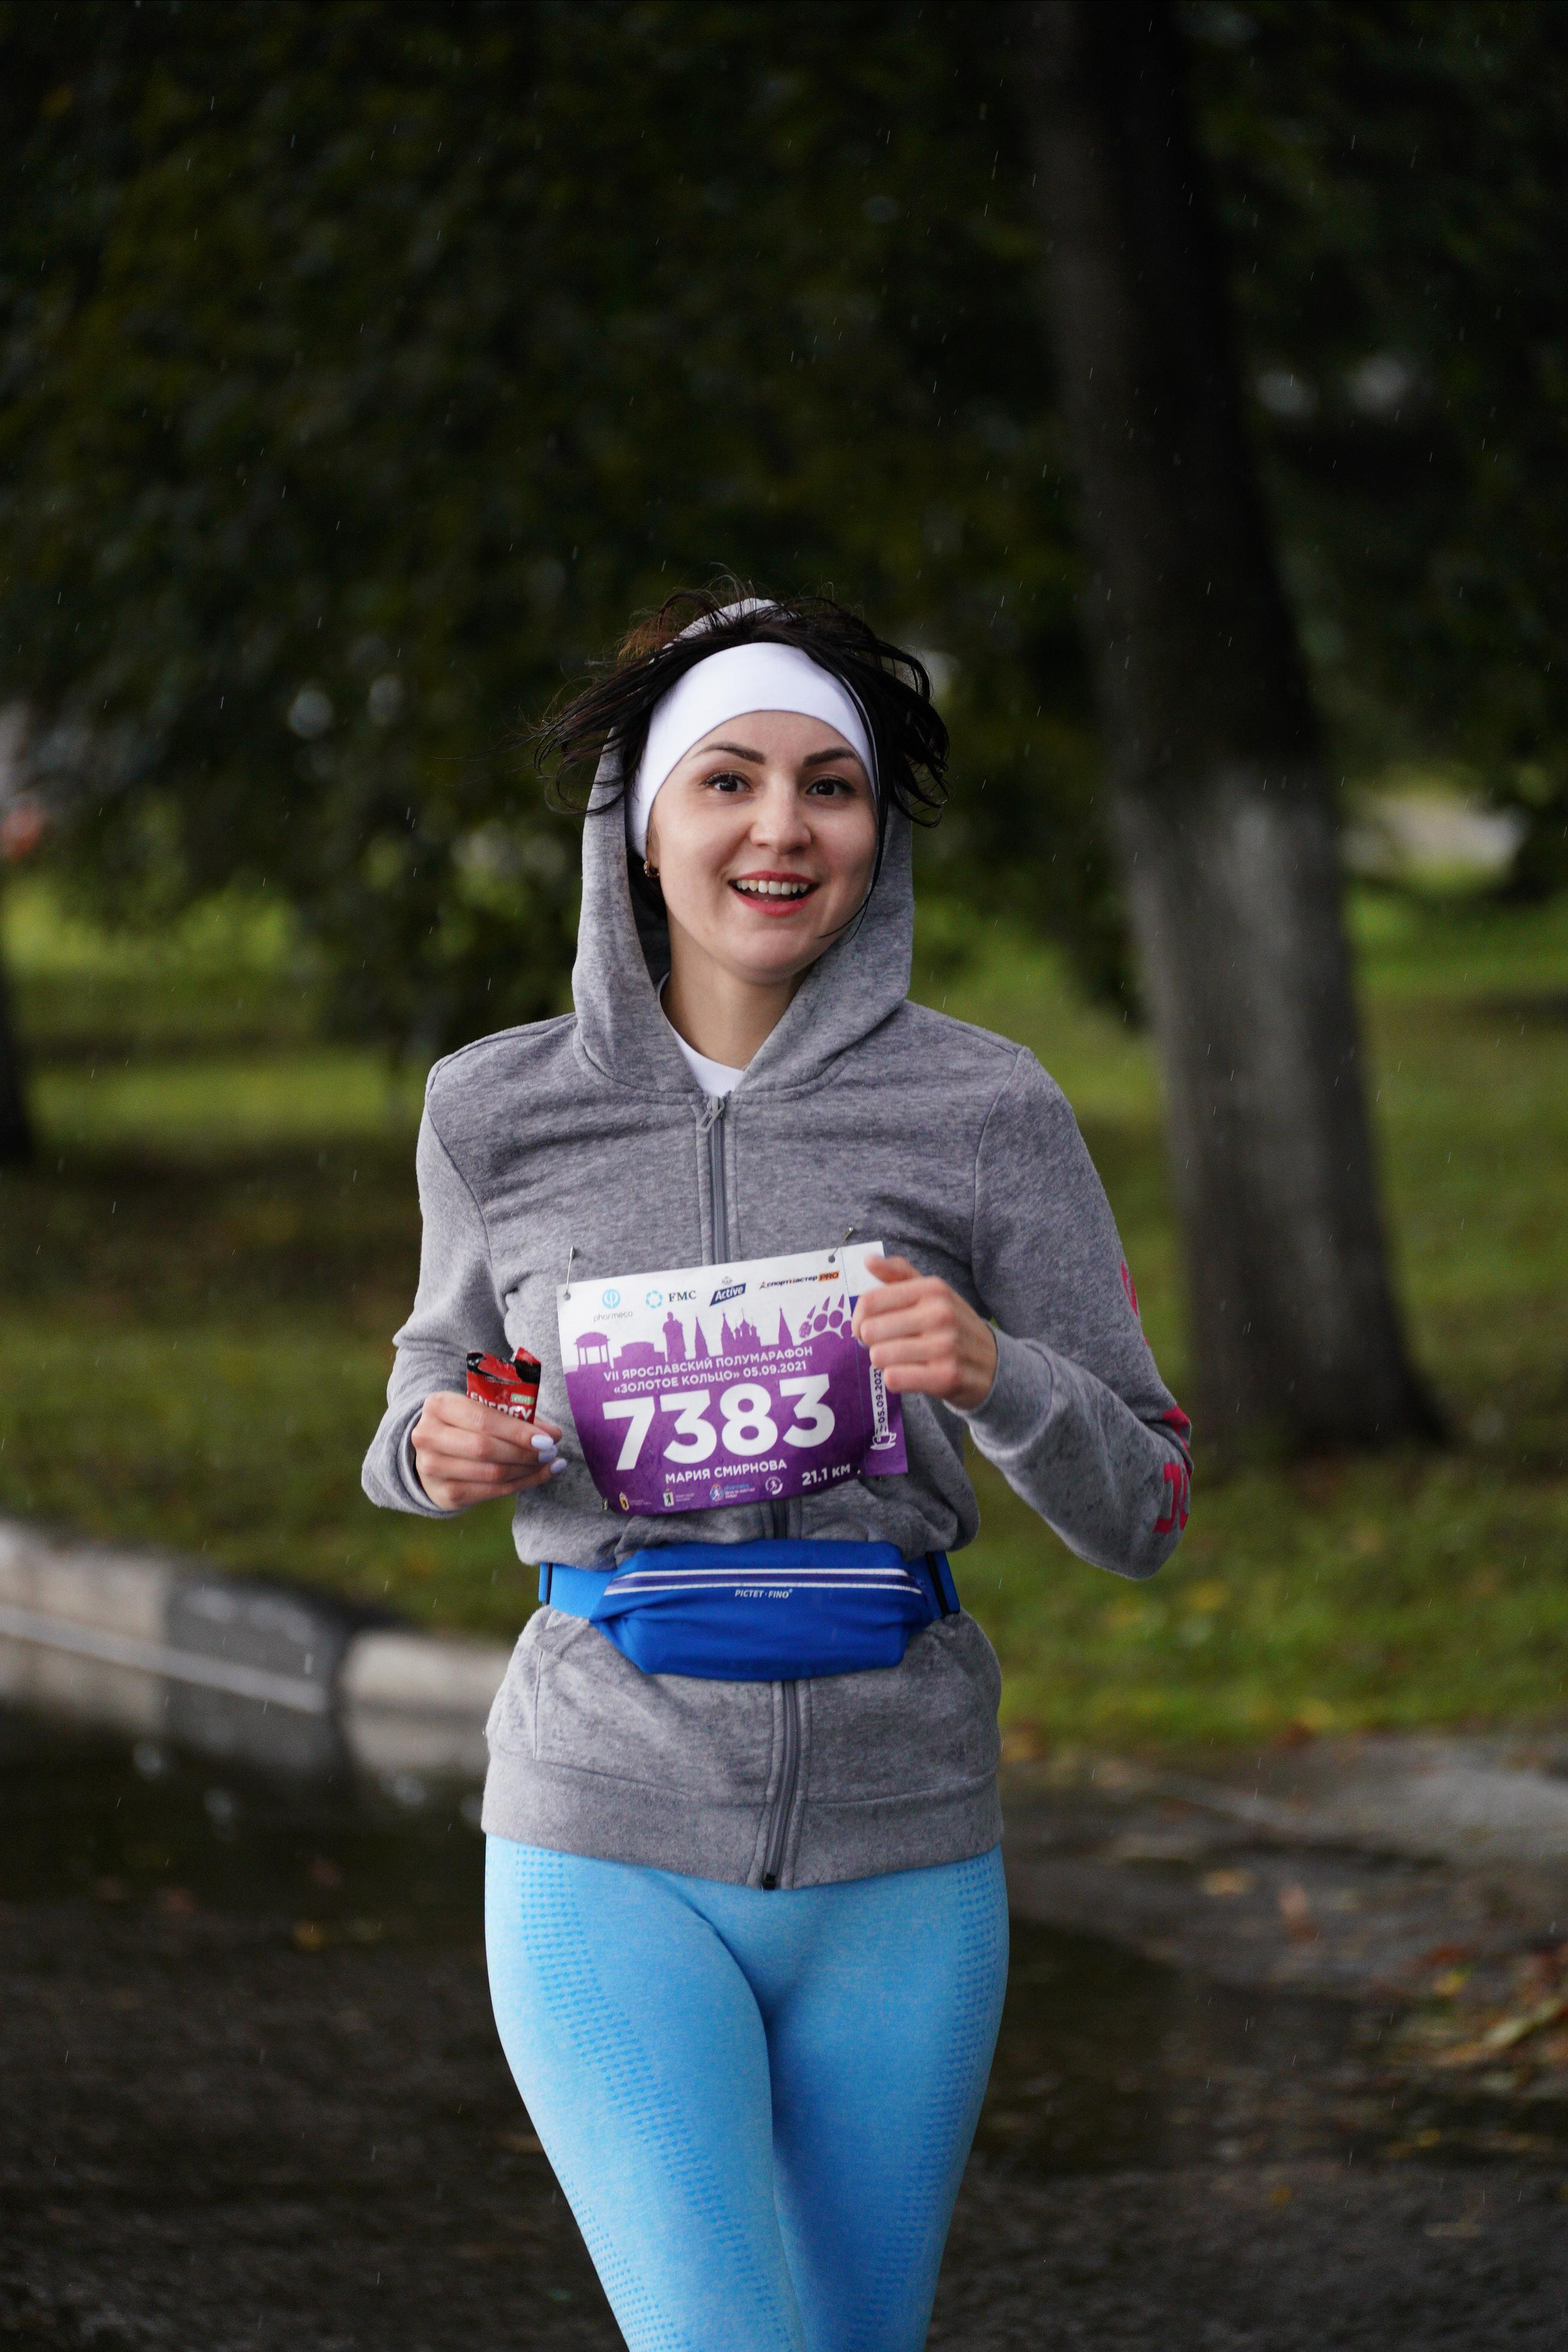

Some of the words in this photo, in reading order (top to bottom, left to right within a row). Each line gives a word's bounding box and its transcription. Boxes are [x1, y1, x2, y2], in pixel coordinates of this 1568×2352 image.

[819, 1272, 839, 1281] PRO
[668, 1290, 697, 1302] FMC
[715, 1285, 744, 1302] Active
[593, 1310, 633, 1323] pharmeco
[603, 1371, 619, 1381] VII
[622, 1357, 713, 1380] ЯРОСЛАВСКИЙ
[715, 1346, 813, 1368] ПОЛУМАРАФОН
[613, 1377, 679, 1395] «ЗОЛОТОЕ
[743, 1360, 807, 1378] 05.09.2021
[601, 1373, 835, 1471] 7383
[665, 1468, 711, 1485] МАРИЯ
[714, 1458, 788, 1479] СМИРНОВА
[801, 1468, 827, 1487] 21.1
